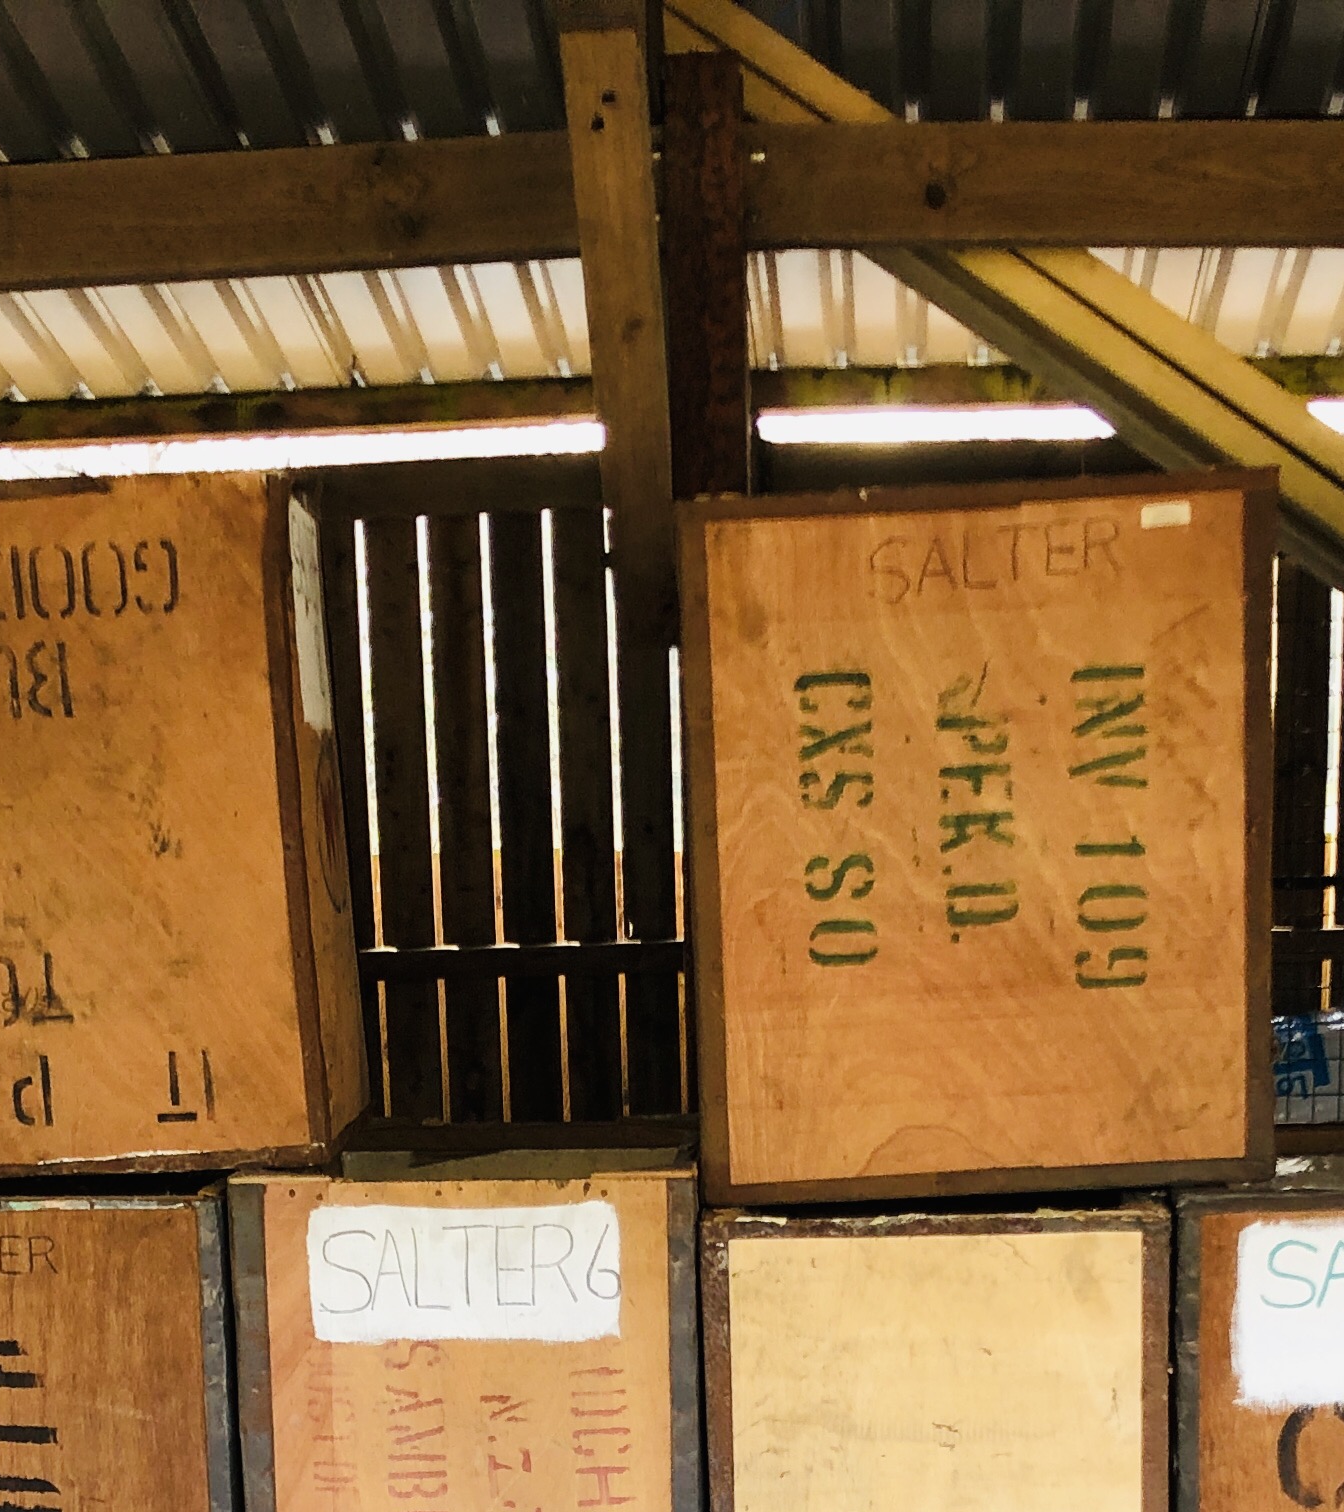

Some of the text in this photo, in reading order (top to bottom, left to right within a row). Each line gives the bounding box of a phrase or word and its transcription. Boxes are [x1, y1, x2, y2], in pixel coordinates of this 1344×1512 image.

[868, 518, 1122, 604] SALTER
[1069, 658, 1149, 990] INV 109
[157, 1048, 216, 1123] IT
[318, 1222, 621, 1316] SALTER 6
